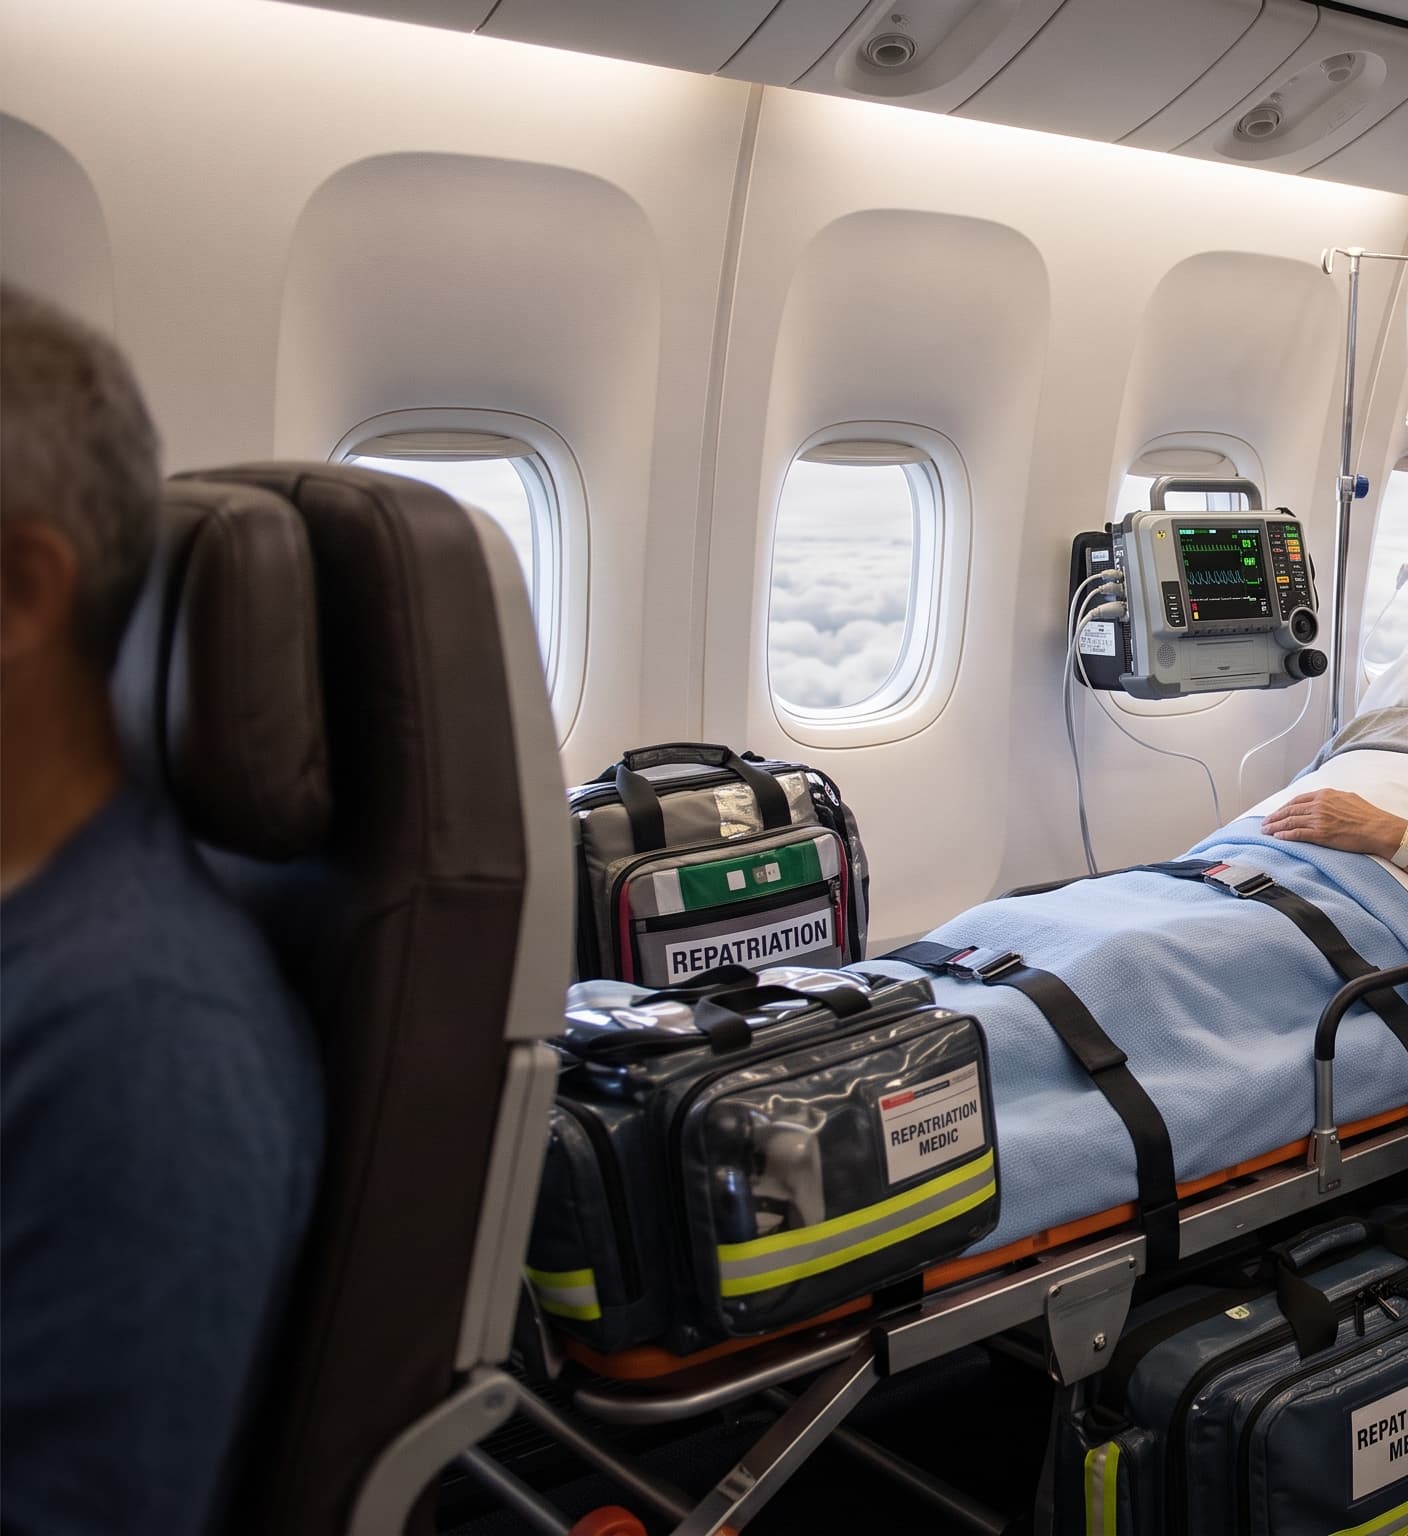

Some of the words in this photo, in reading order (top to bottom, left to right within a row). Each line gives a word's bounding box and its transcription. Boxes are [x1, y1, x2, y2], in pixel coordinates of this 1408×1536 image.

[672, 918, 828, 974] REPATRIATION
[891, 1099, 978, 1147] REPATRIATION
[919, 1128, 959, 1156] MEDIC
